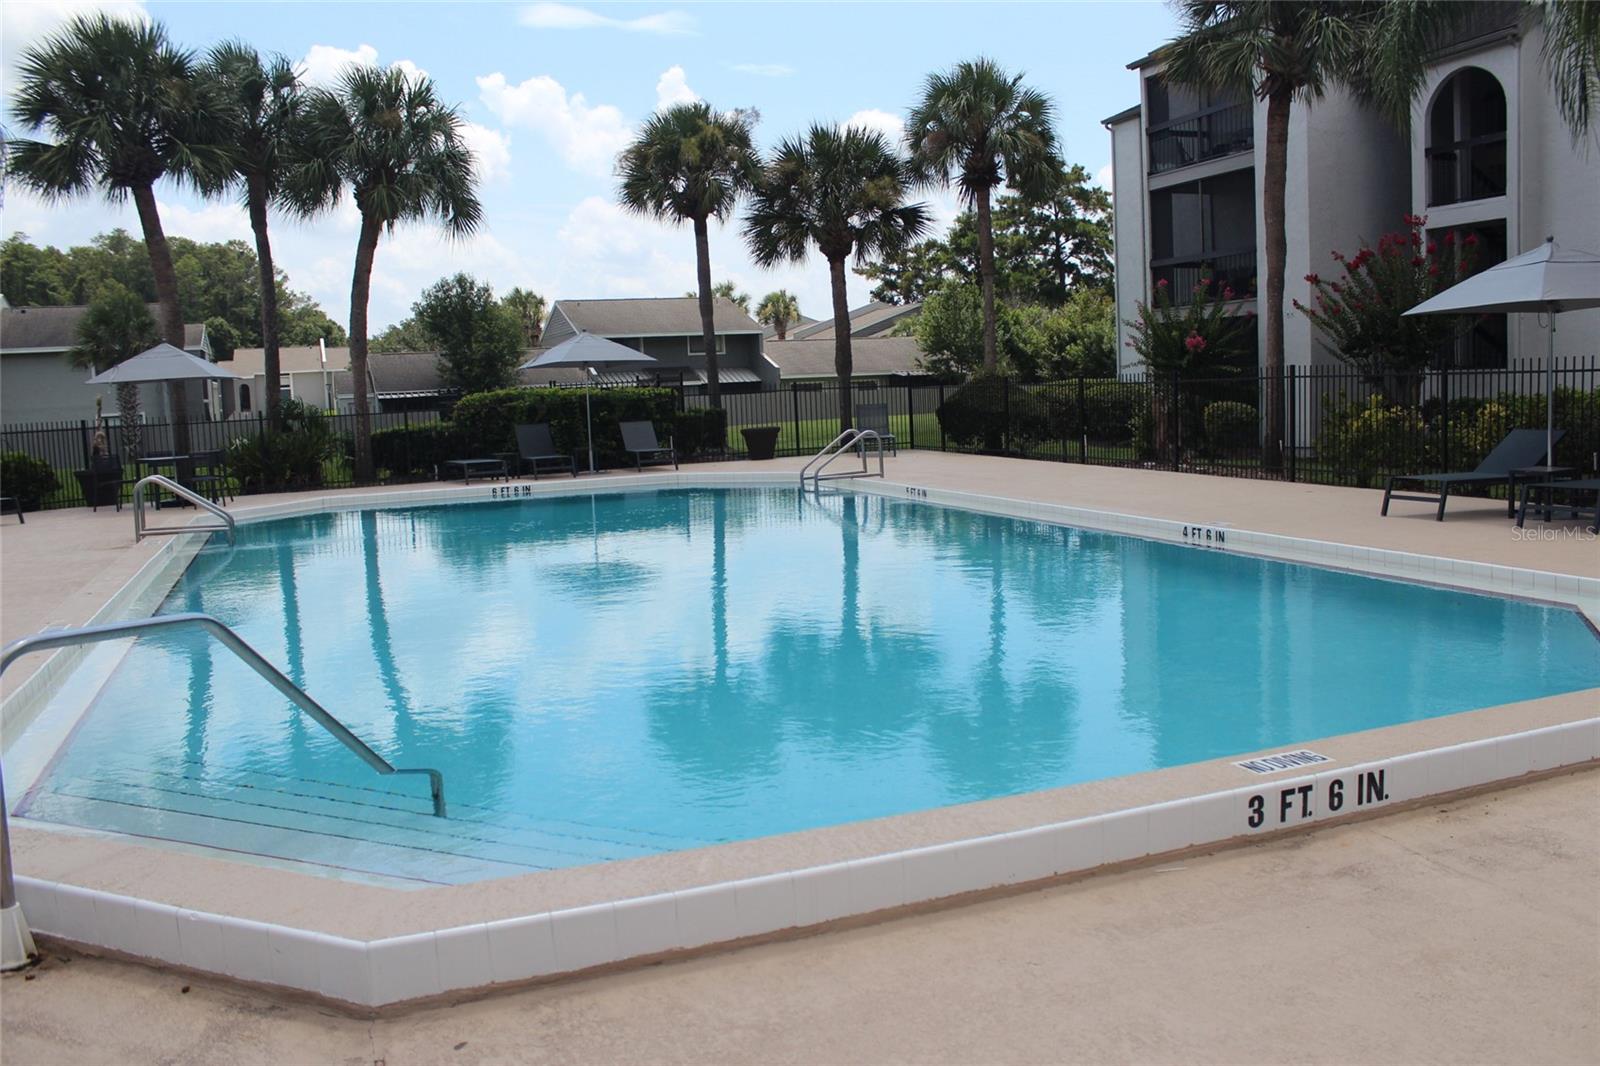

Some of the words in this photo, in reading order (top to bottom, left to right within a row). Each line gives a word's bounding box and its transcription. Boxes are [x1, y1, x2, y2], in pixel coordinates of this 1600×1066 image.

[1182, 526, 1188, 537] 4
[1191, 527, 1202, 539] FT
[1206, 528, 1212, 541] 6
[1215, 530, 1225, 543] IN
[1238, 760, 1275, 774] NO
[1261, 751, 1329, 770] DIVING
[1248, 794, 1265, 828] 3
[1280, 784, 1313, 823] FT.
[1328, 778, 1344, 811] 6
[1357, 769, 1389, 806] IN.
